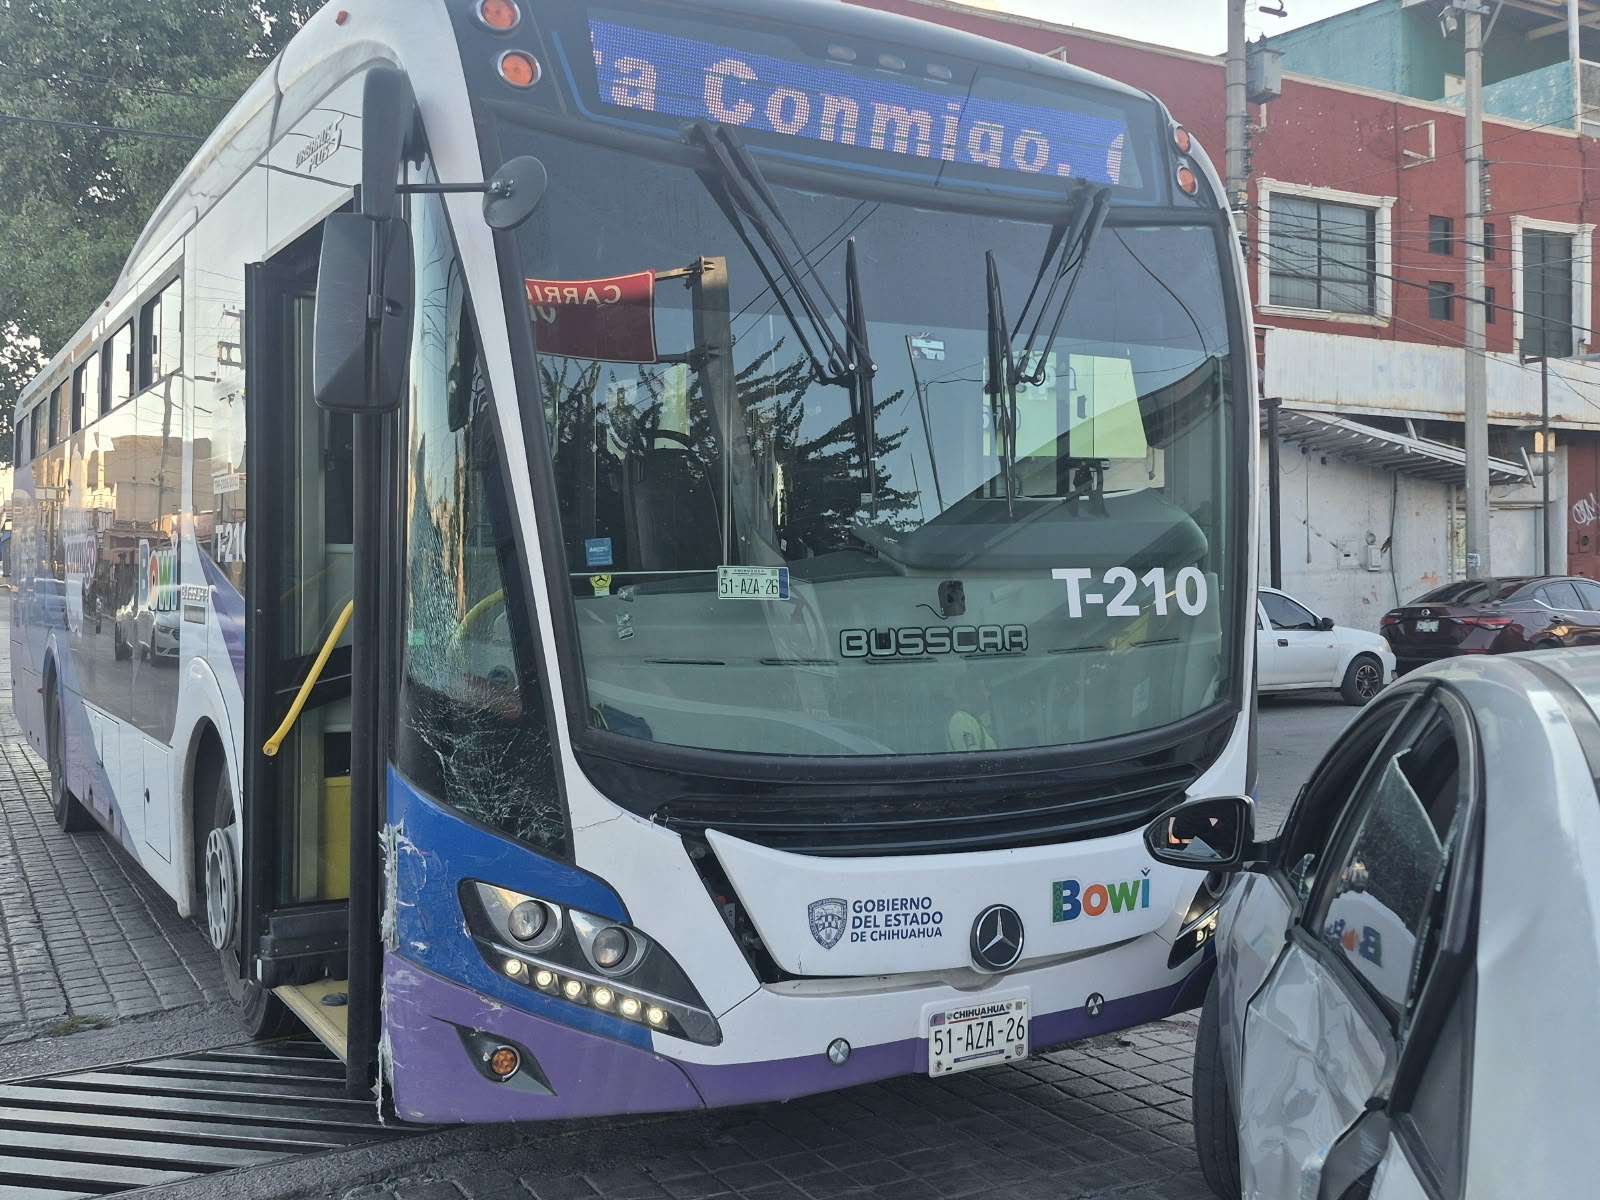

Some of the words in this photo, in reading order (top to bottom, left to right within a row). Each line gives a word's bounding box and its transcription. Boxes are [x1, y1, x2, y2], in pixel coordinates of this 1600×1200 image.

[720, 577, 779, 595] 51-AZA-26
[1051, 566, 1208, 618] T-210
[839, 623, 1029, 658] BUSSCAR
[852, 896, 933, 914] GOBIERNO
[851, 915, 880, 929] DEL
[884, 911, 943, 927] ESTADO
[850, 931, 867, 942] DE
[870, 927, 943, 941] CHIHUAHUA
[953, 1004, 1006, 1019] CHIHUAHUA
[934, 1016, 1025, 1055] 51-AZA-26
